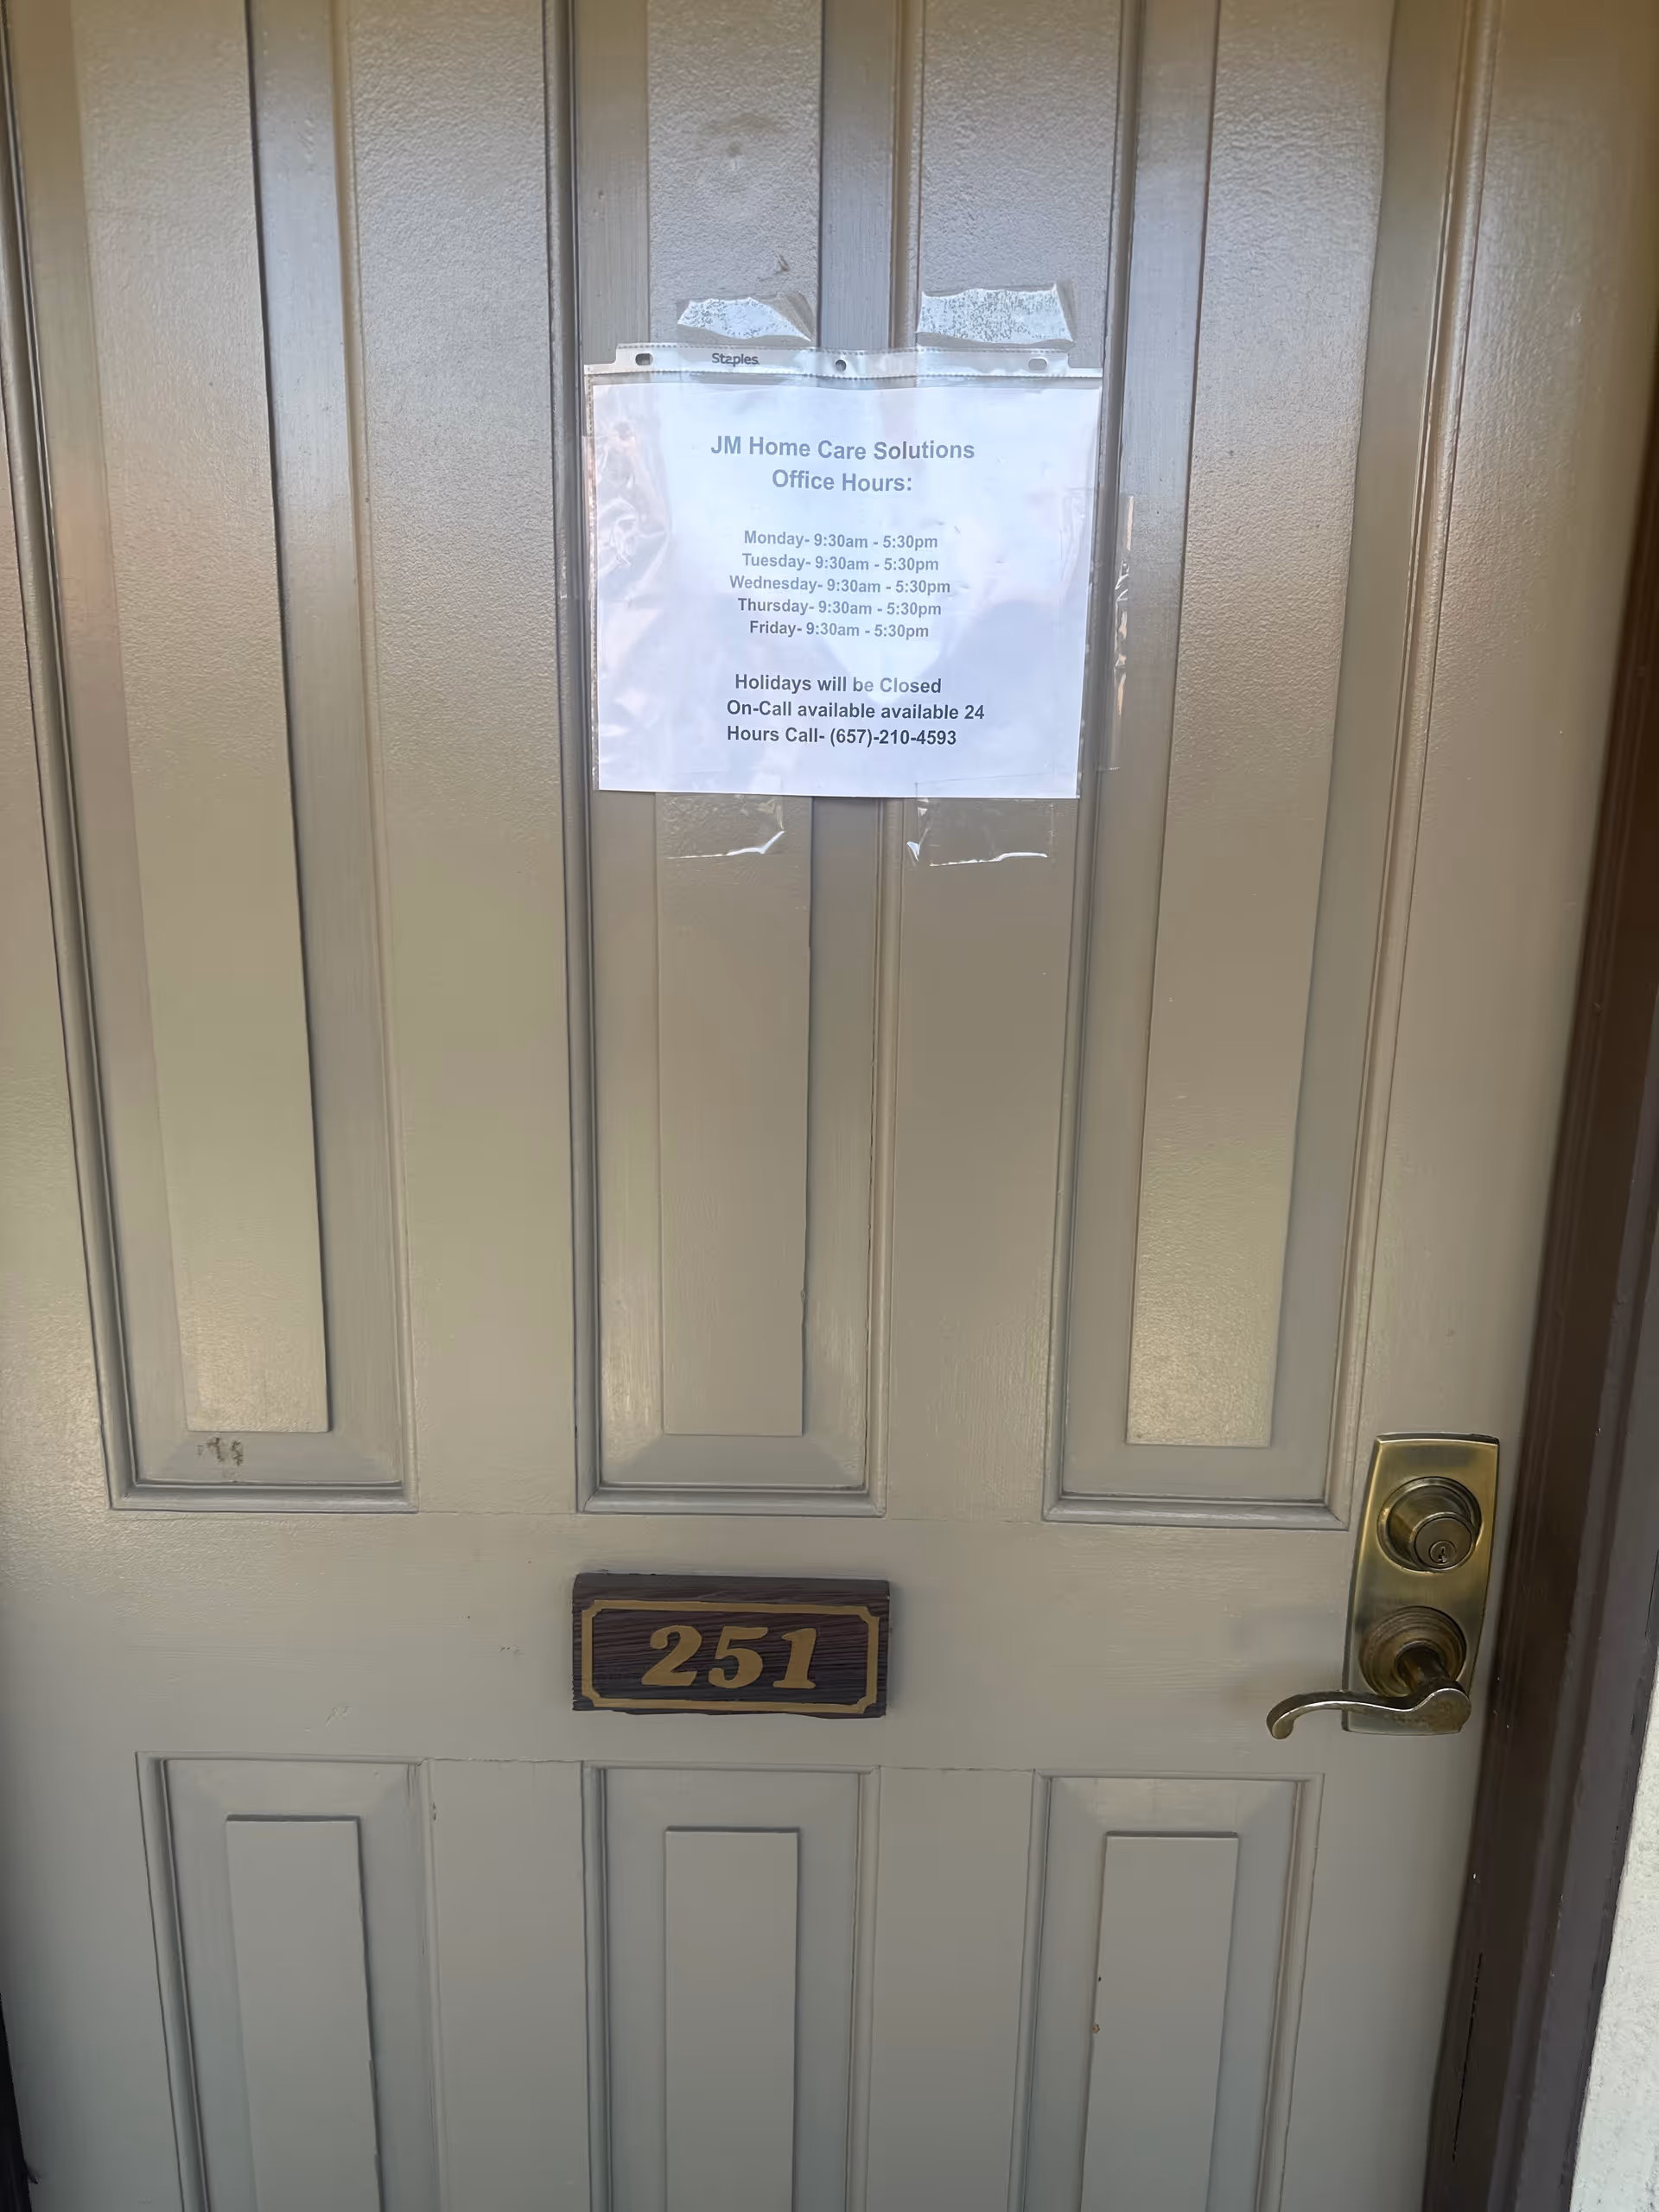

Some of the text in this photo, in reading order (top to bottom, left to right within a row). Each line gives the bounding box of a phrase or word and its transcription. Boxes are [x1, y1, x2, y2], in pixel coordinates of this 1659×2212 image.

[712, 353, 760, 367] Staples
[711, 435, 975, 460] JM Home Care Solutions
[772, 469, 912, 492] Office Hours:
[744, 531, 810, 548] Monday-
[814, 533, 868, 548] 9:30am
[883, 535, 938, 551] 5:30pm
[742, 553, 810, 571] Tuesday-
[815, 556, 869, 570] 9:30am
[884, 558, 939, 574] 5:30pm
[729, 575, 823, 594] Wednesday-
[827, 579, 880, 593] 9:30am
[895, 581, 950, 595] 5:30pm
[738, 598, 814, 616] Thursday-
[818, 601, 872, 615] 9:30am
[887, 602, 941, 618] 5:30pm
[750, 620, 802, 638] Friday-
[806, 622, 860, 637] 9:30am
[874, 625, 929, 640] 5:30pm
[735, 674, 942, 694] Holidays will be Closed
[727, 700, 984, 720] On-Call available available 24
[728, 726, 957, 747] Hours Call- (657)-210-4593
[641, 1624, 817, 1688] 251
